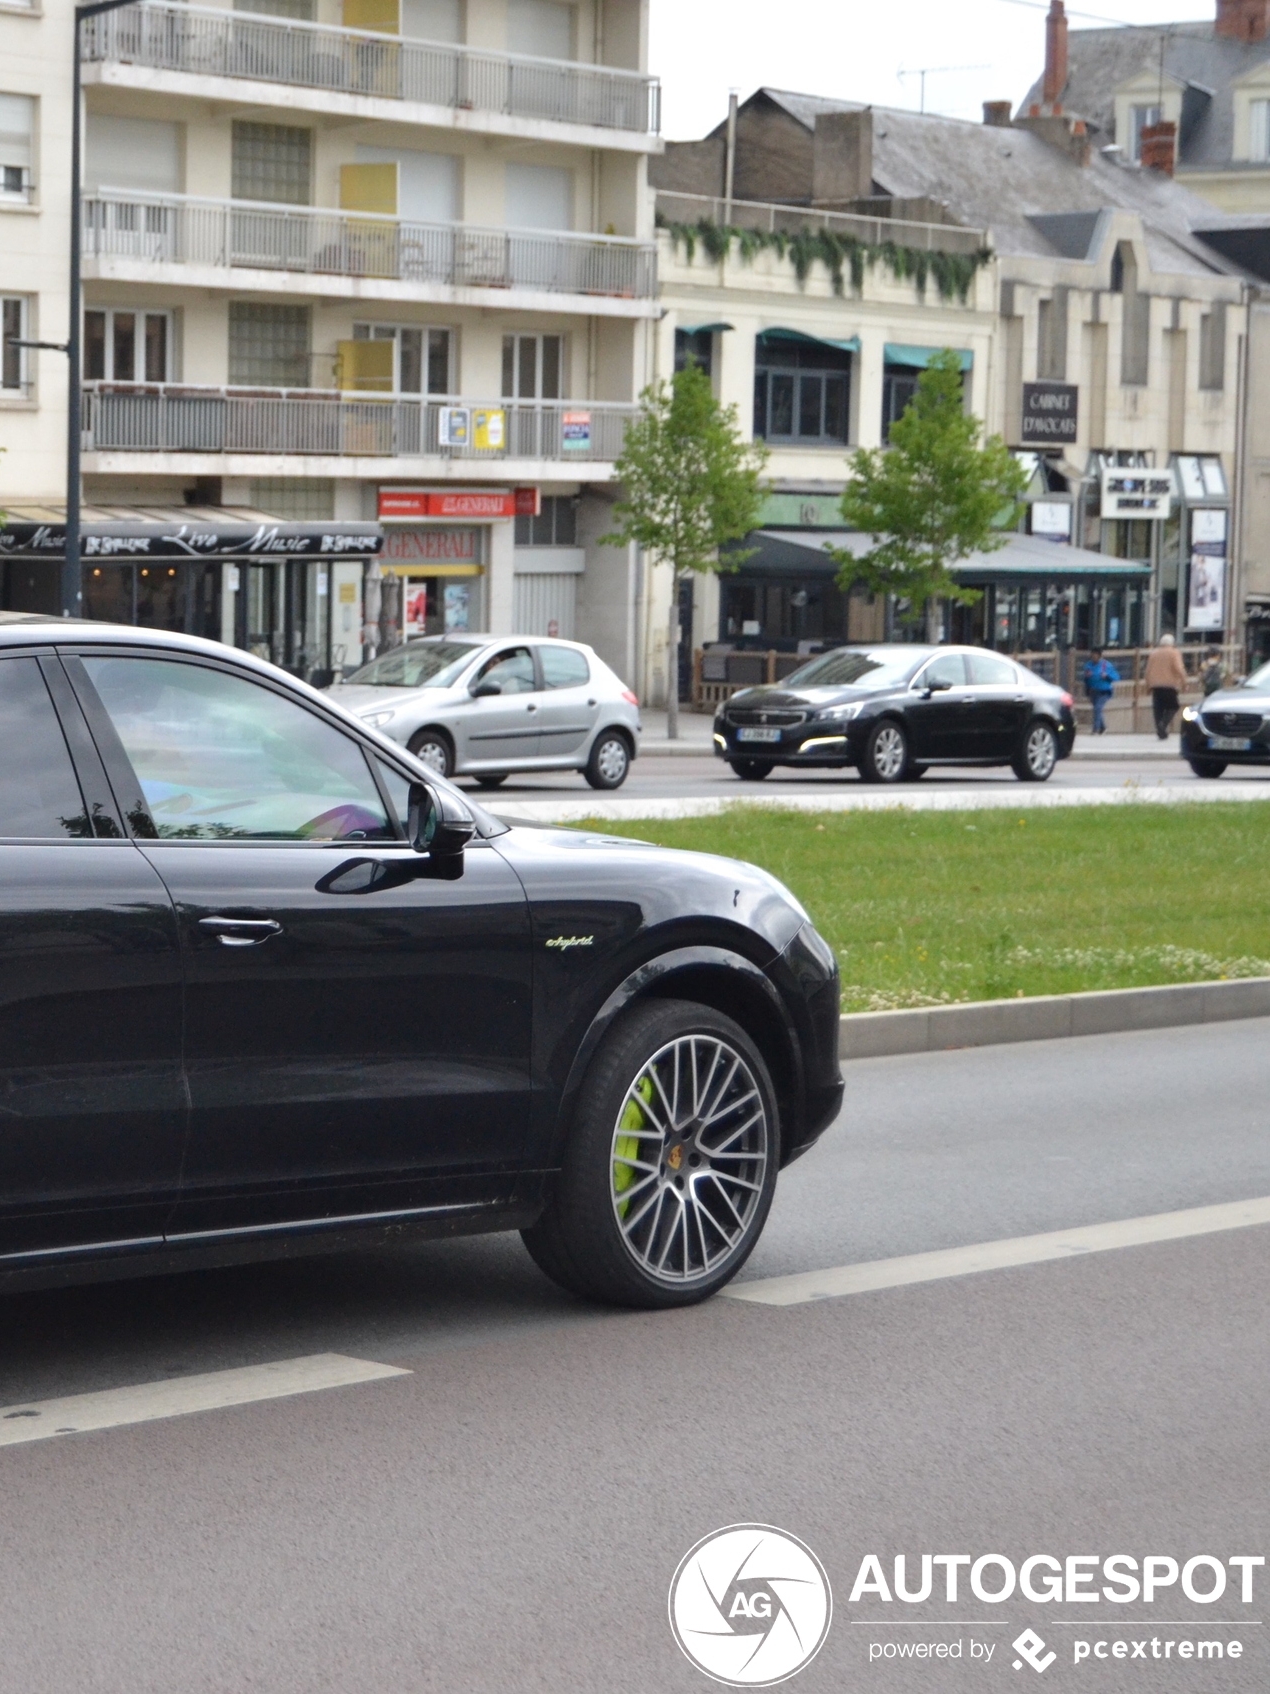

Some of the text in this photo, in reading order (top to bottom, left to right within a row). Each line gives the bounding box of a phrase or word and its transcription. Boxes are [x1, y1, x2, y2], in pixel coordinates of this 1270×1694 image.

[456, 497, 504, 512] GENERALI
[161, 525, 219, 555] Live
[221, 525, 310, 553] Music
[386, 531, 476, 559] GENERALI
